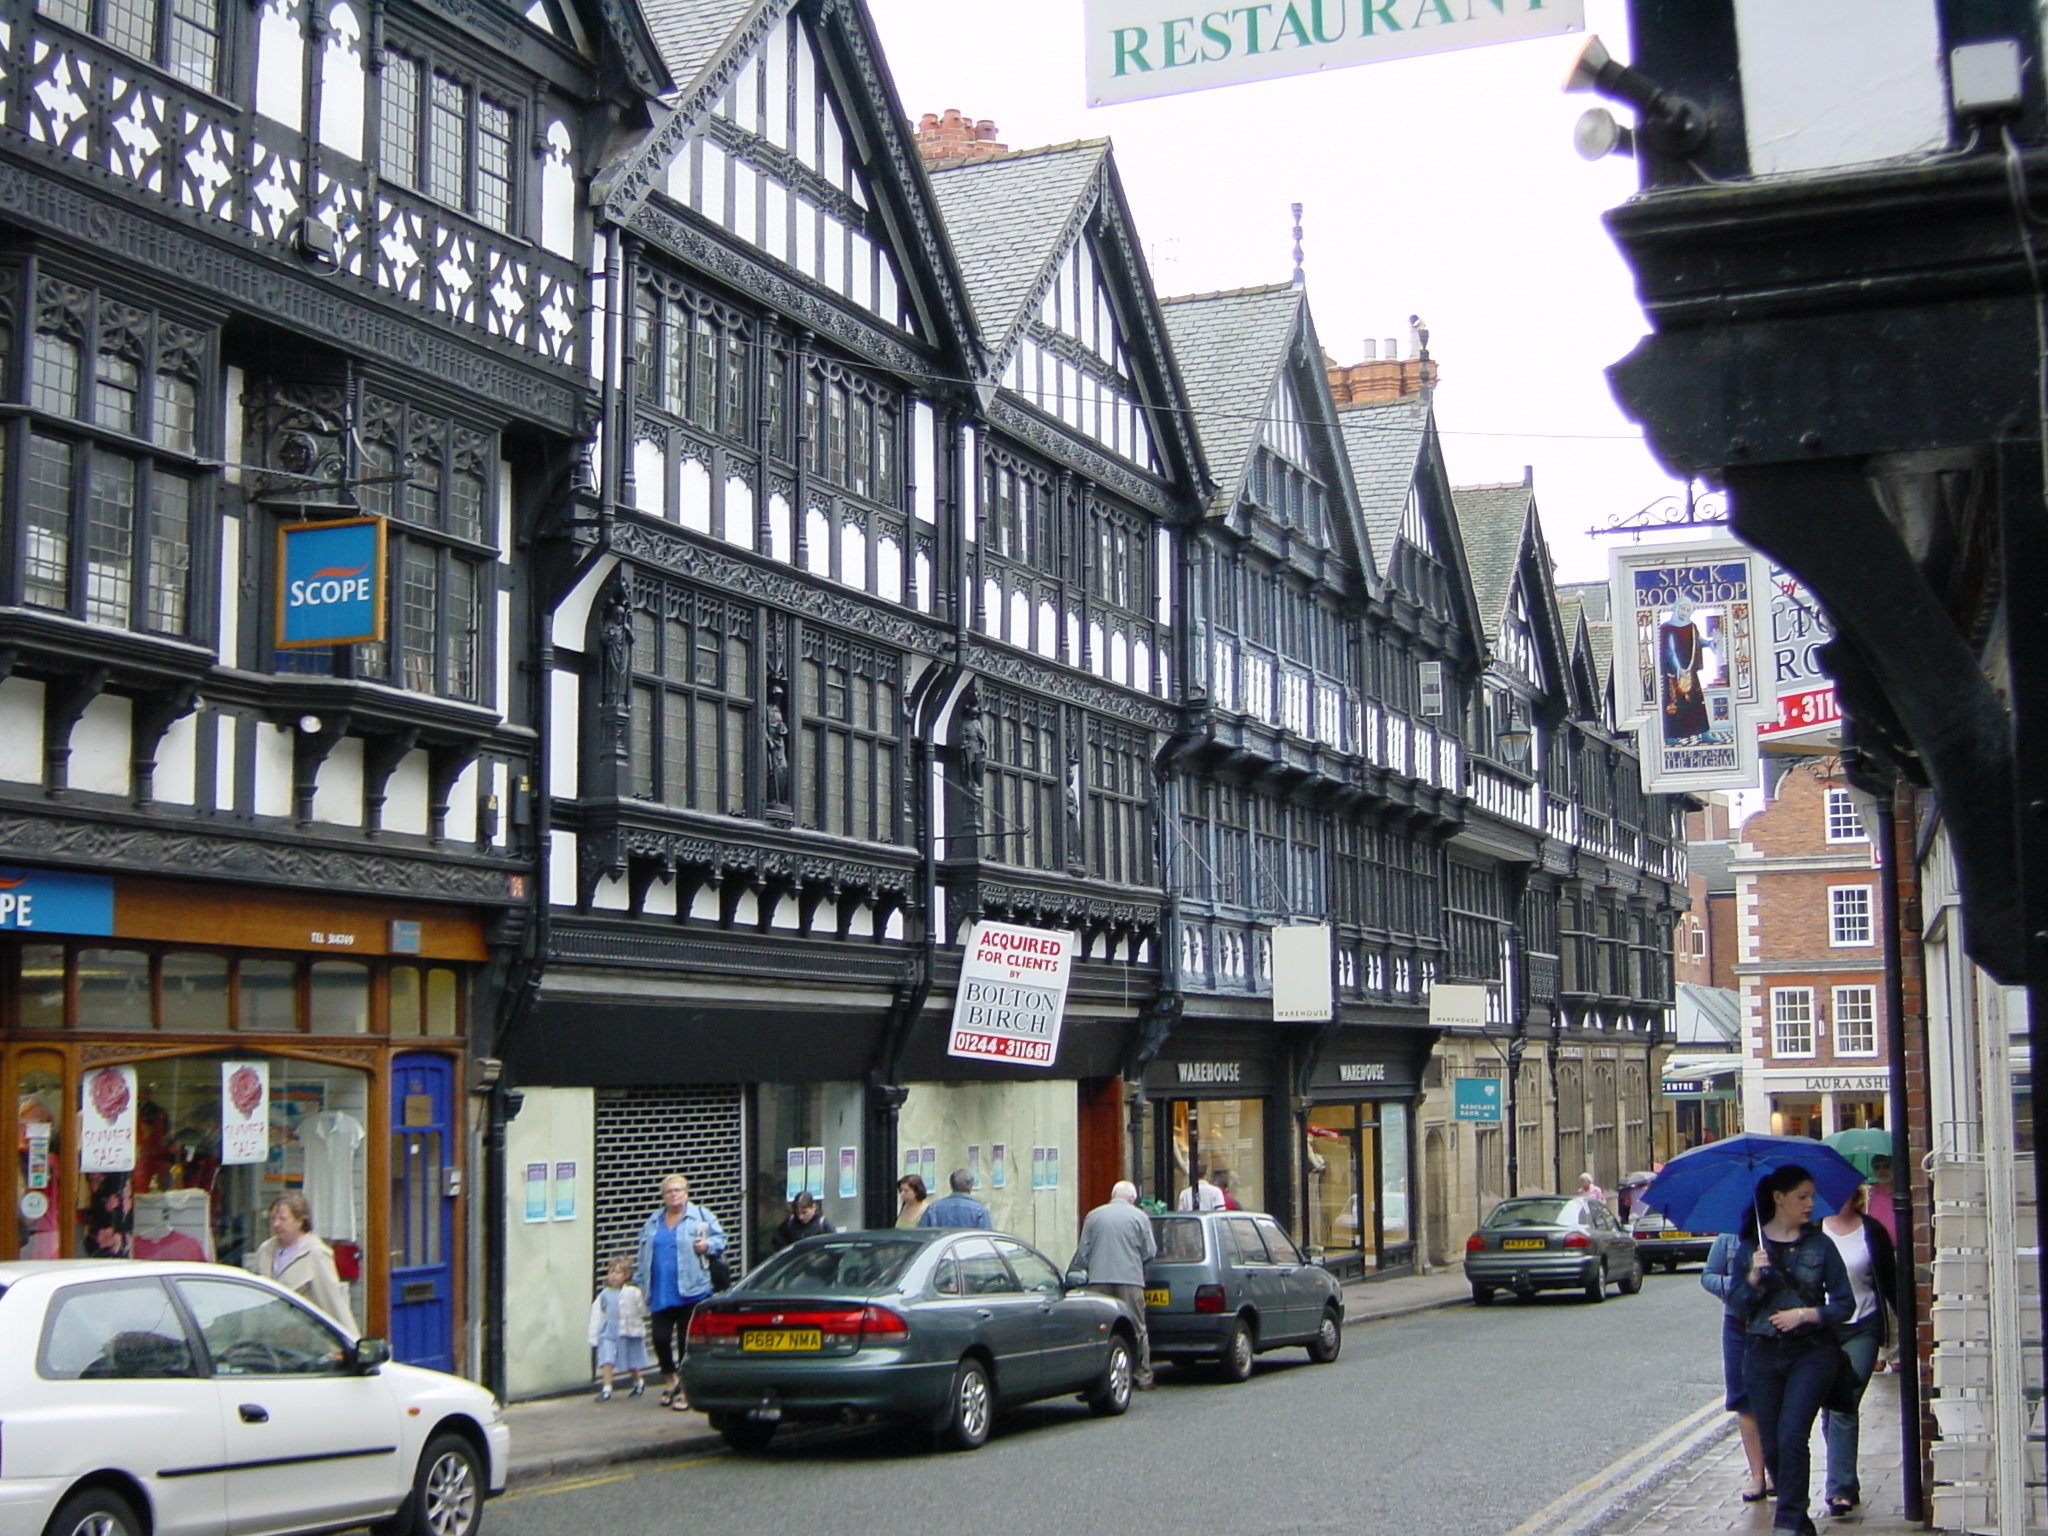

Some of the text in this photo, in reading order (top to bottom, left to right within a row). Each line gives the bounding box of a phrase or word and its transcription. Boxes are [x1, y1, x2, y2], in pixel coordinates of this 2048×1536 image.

[290, 578, 370, 607] SCOPE
[1635, 582, 1746, 607] BOOKSHOP
[1665, 755, 1734, 770] THE PILGRIM
[980, 931, 1061, 956] ACQUIRED
[977, 949, 1059, 972] FOR CLIENTS
[1009, 970, 1021, 979] BY
[966, 983, 1058, 1012] BOLTON
[968, 1006, 1046, 1034] BIRCH
[1177, 1062, 1240, 1083] WAREHOUSE
[1339, 1064, 1385, 1082] WAREHOUSE
[1806, 1078, 1852, 1090] LAURA
[745, 1333, 819, 1347] P687 NMA
